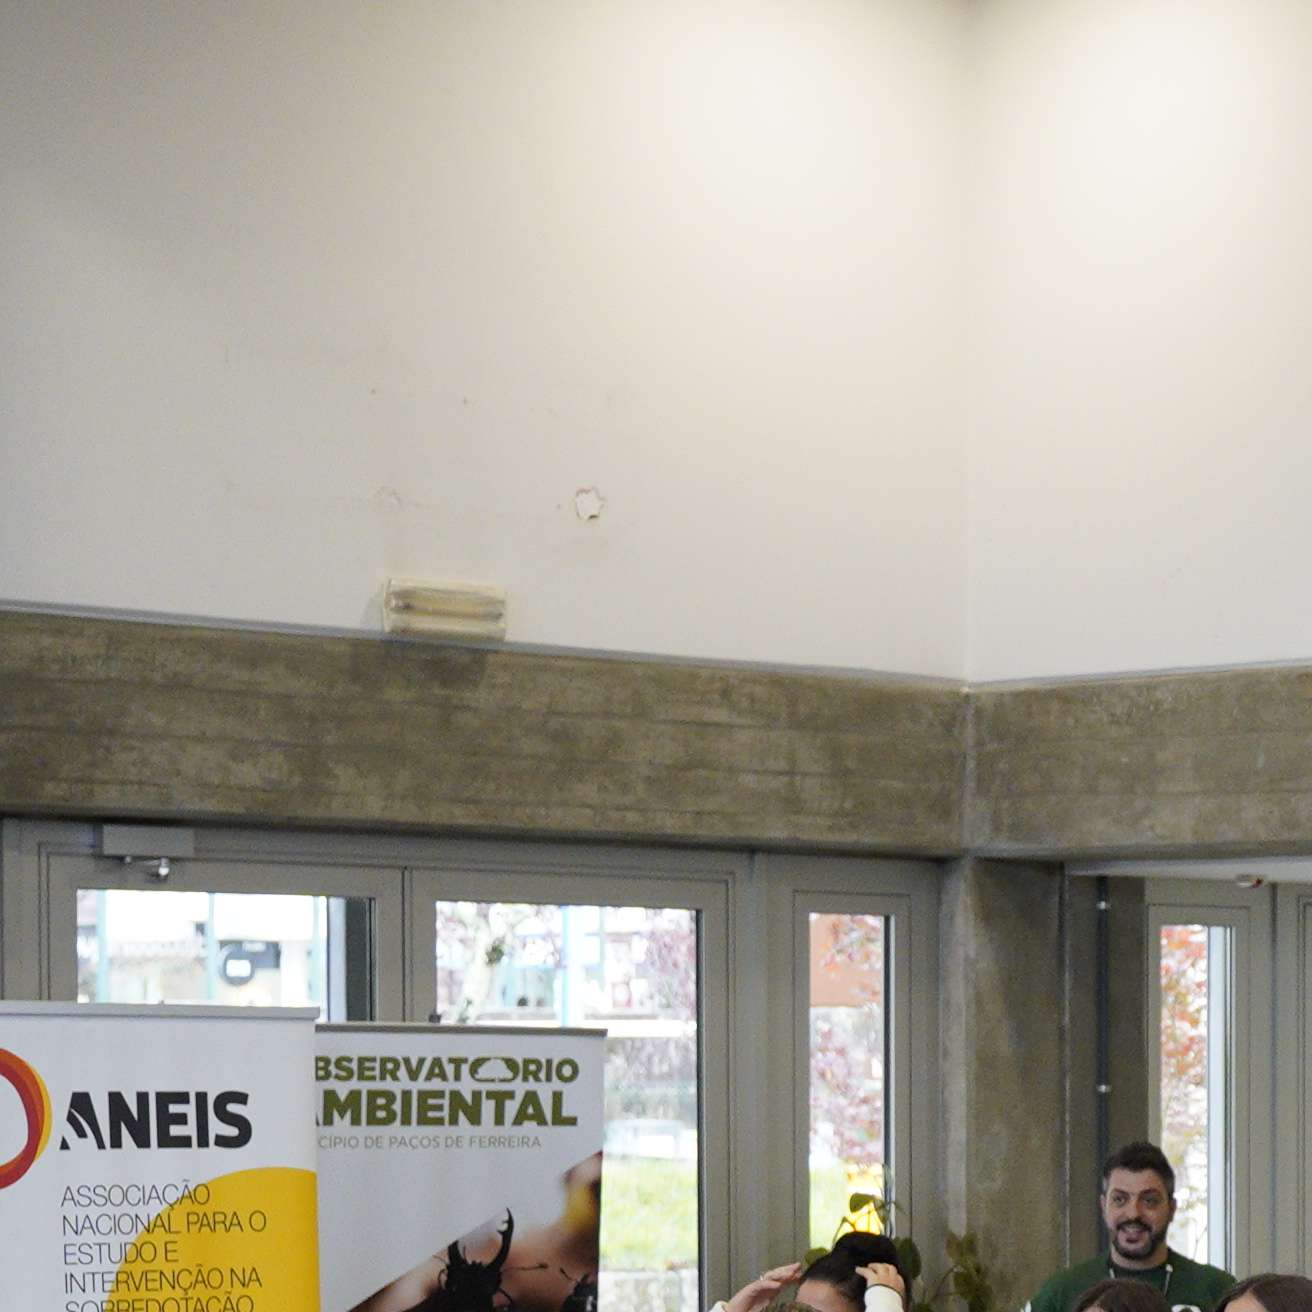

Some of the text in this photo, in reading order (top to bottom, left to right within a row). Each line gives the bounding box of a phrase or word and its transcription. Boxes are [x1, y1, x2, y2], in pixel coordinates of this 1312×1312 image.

[315, 1056, 579, 1083] BSERVATORIO
[59, 1091, 252, 1150] ANEIS
[316, 1089, 578, 1127] MBIENTAL
[318, 1133, 542, 1151] CÍPIO DE PAÇOS DE FERREIRA
[61, 1179, 210, 1209] ASSOCIAÇÃO
[63, 1210, 267, 1236] NACIONAL PARA O
[64, 1241, 179, 1265] ESTUDO E
[64, 1264, 263, 1295] INTERVENÇÃO NA
